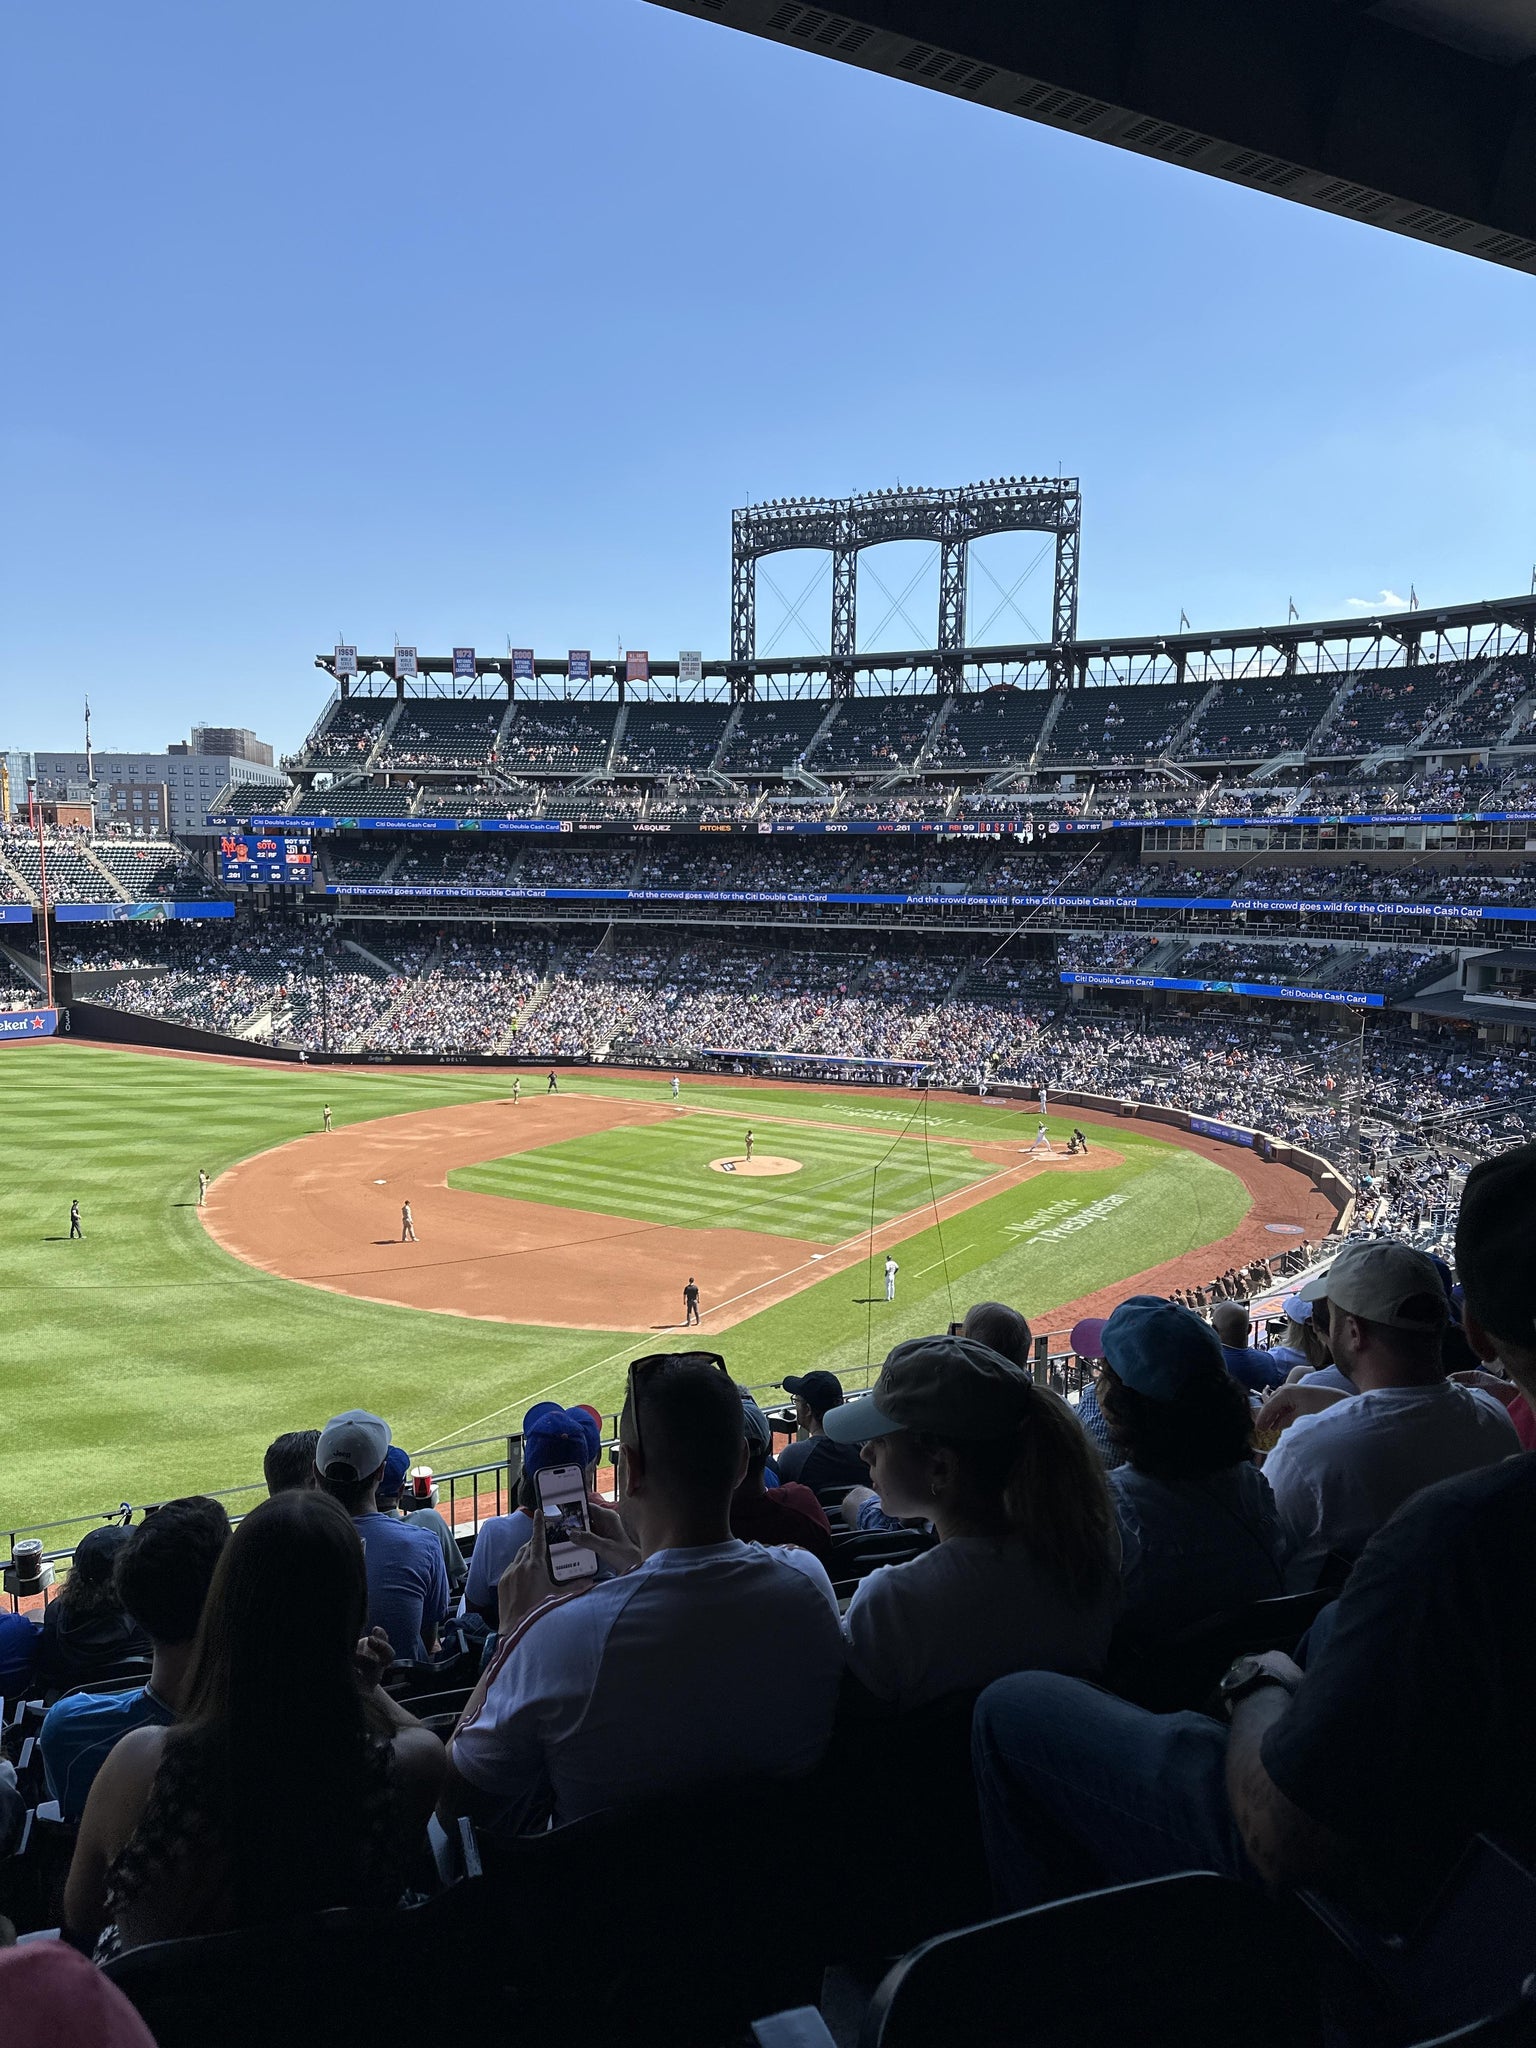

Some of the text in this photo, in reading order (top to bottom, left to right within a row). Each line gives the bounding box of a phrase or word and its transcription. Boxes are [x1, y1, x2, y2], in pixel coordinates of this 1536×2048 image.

[338, 648, 354, 656] 1969
[257, 842, 276, 850] SOTO
[1042, 897, 1057, 905] Citi
[1059, 897, 1091, 905] Double
[1092, 898, 1114, 906] Cash
[1116, 898, 1137, 906] Card
[1323, 903, 1342, 911] wild
[1344, 903, 1357, 911] for
[1359, 904, 1375, 912] the
[1377, 904, 1394, 913] Citi
[1396, 905, 1431, 914] Double
[1433, 906, 1459, 915] Cash
[1461, 907, 1482, 916] Card
[1089, 976, 1114, 984] Double
[1115, 977, 1134, 985] Cash
[1296, 990, 1322, 999] Double
[1324, 993, 1345, 1002] Cash
[1346, 994, 1367, 1003] Card
[1004, 1198, 1082, 1233] NewYork-
[1038, 1194, 1133, 1242] Presbyterian
[333, 1450, 351, 1459] Jeep
